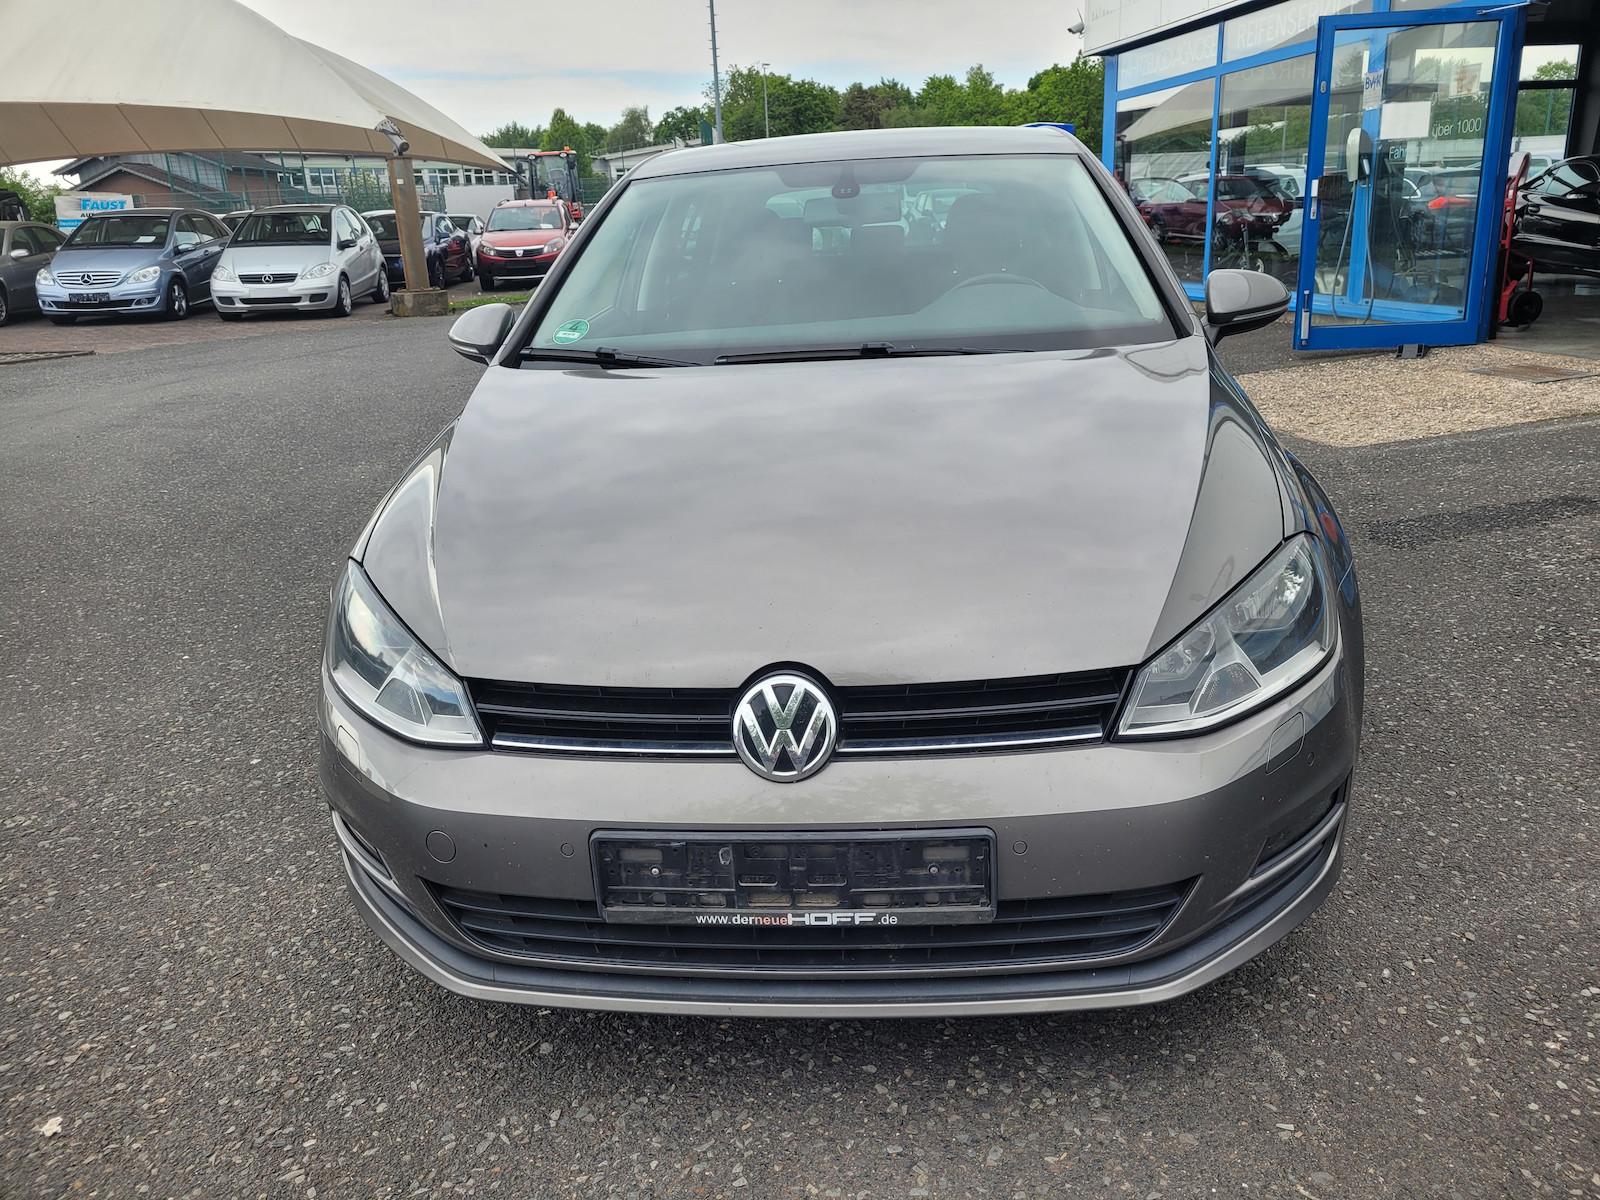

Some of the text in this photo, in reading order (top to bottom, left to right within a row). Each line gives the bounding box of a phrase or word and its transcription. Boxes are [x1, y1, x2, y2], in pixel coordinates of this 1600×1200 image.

[1457, 118, 1482, 133] 1000
[81, 199, 127, 210] FAUST
[695, 912, 898, 926] www.derneueHOFF.de
